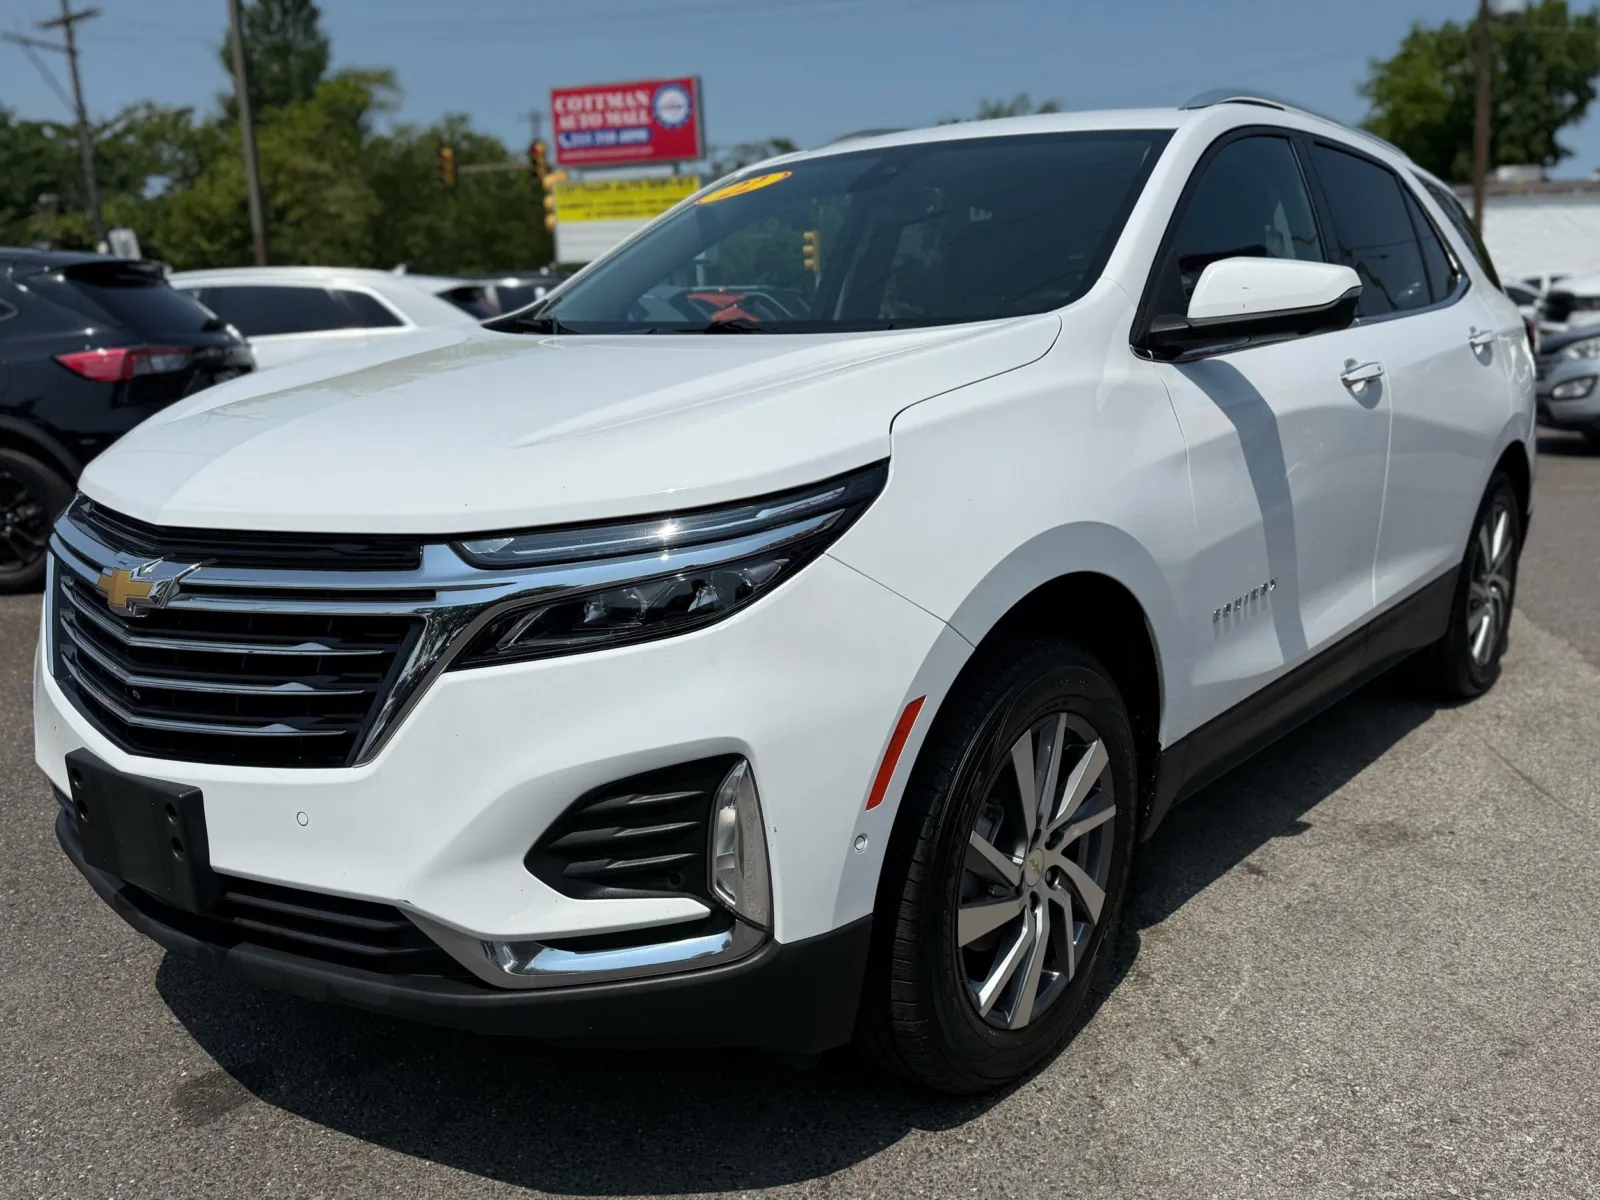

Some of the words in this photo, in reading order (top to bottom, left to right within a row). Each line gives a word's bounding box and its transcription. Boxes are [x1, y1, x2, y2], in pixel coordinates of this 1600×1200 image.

[555, 90, 649, 113] COTTMAN
[559, 112, 603, 129] AUTO
[606, 109, 649, 126] MALL
